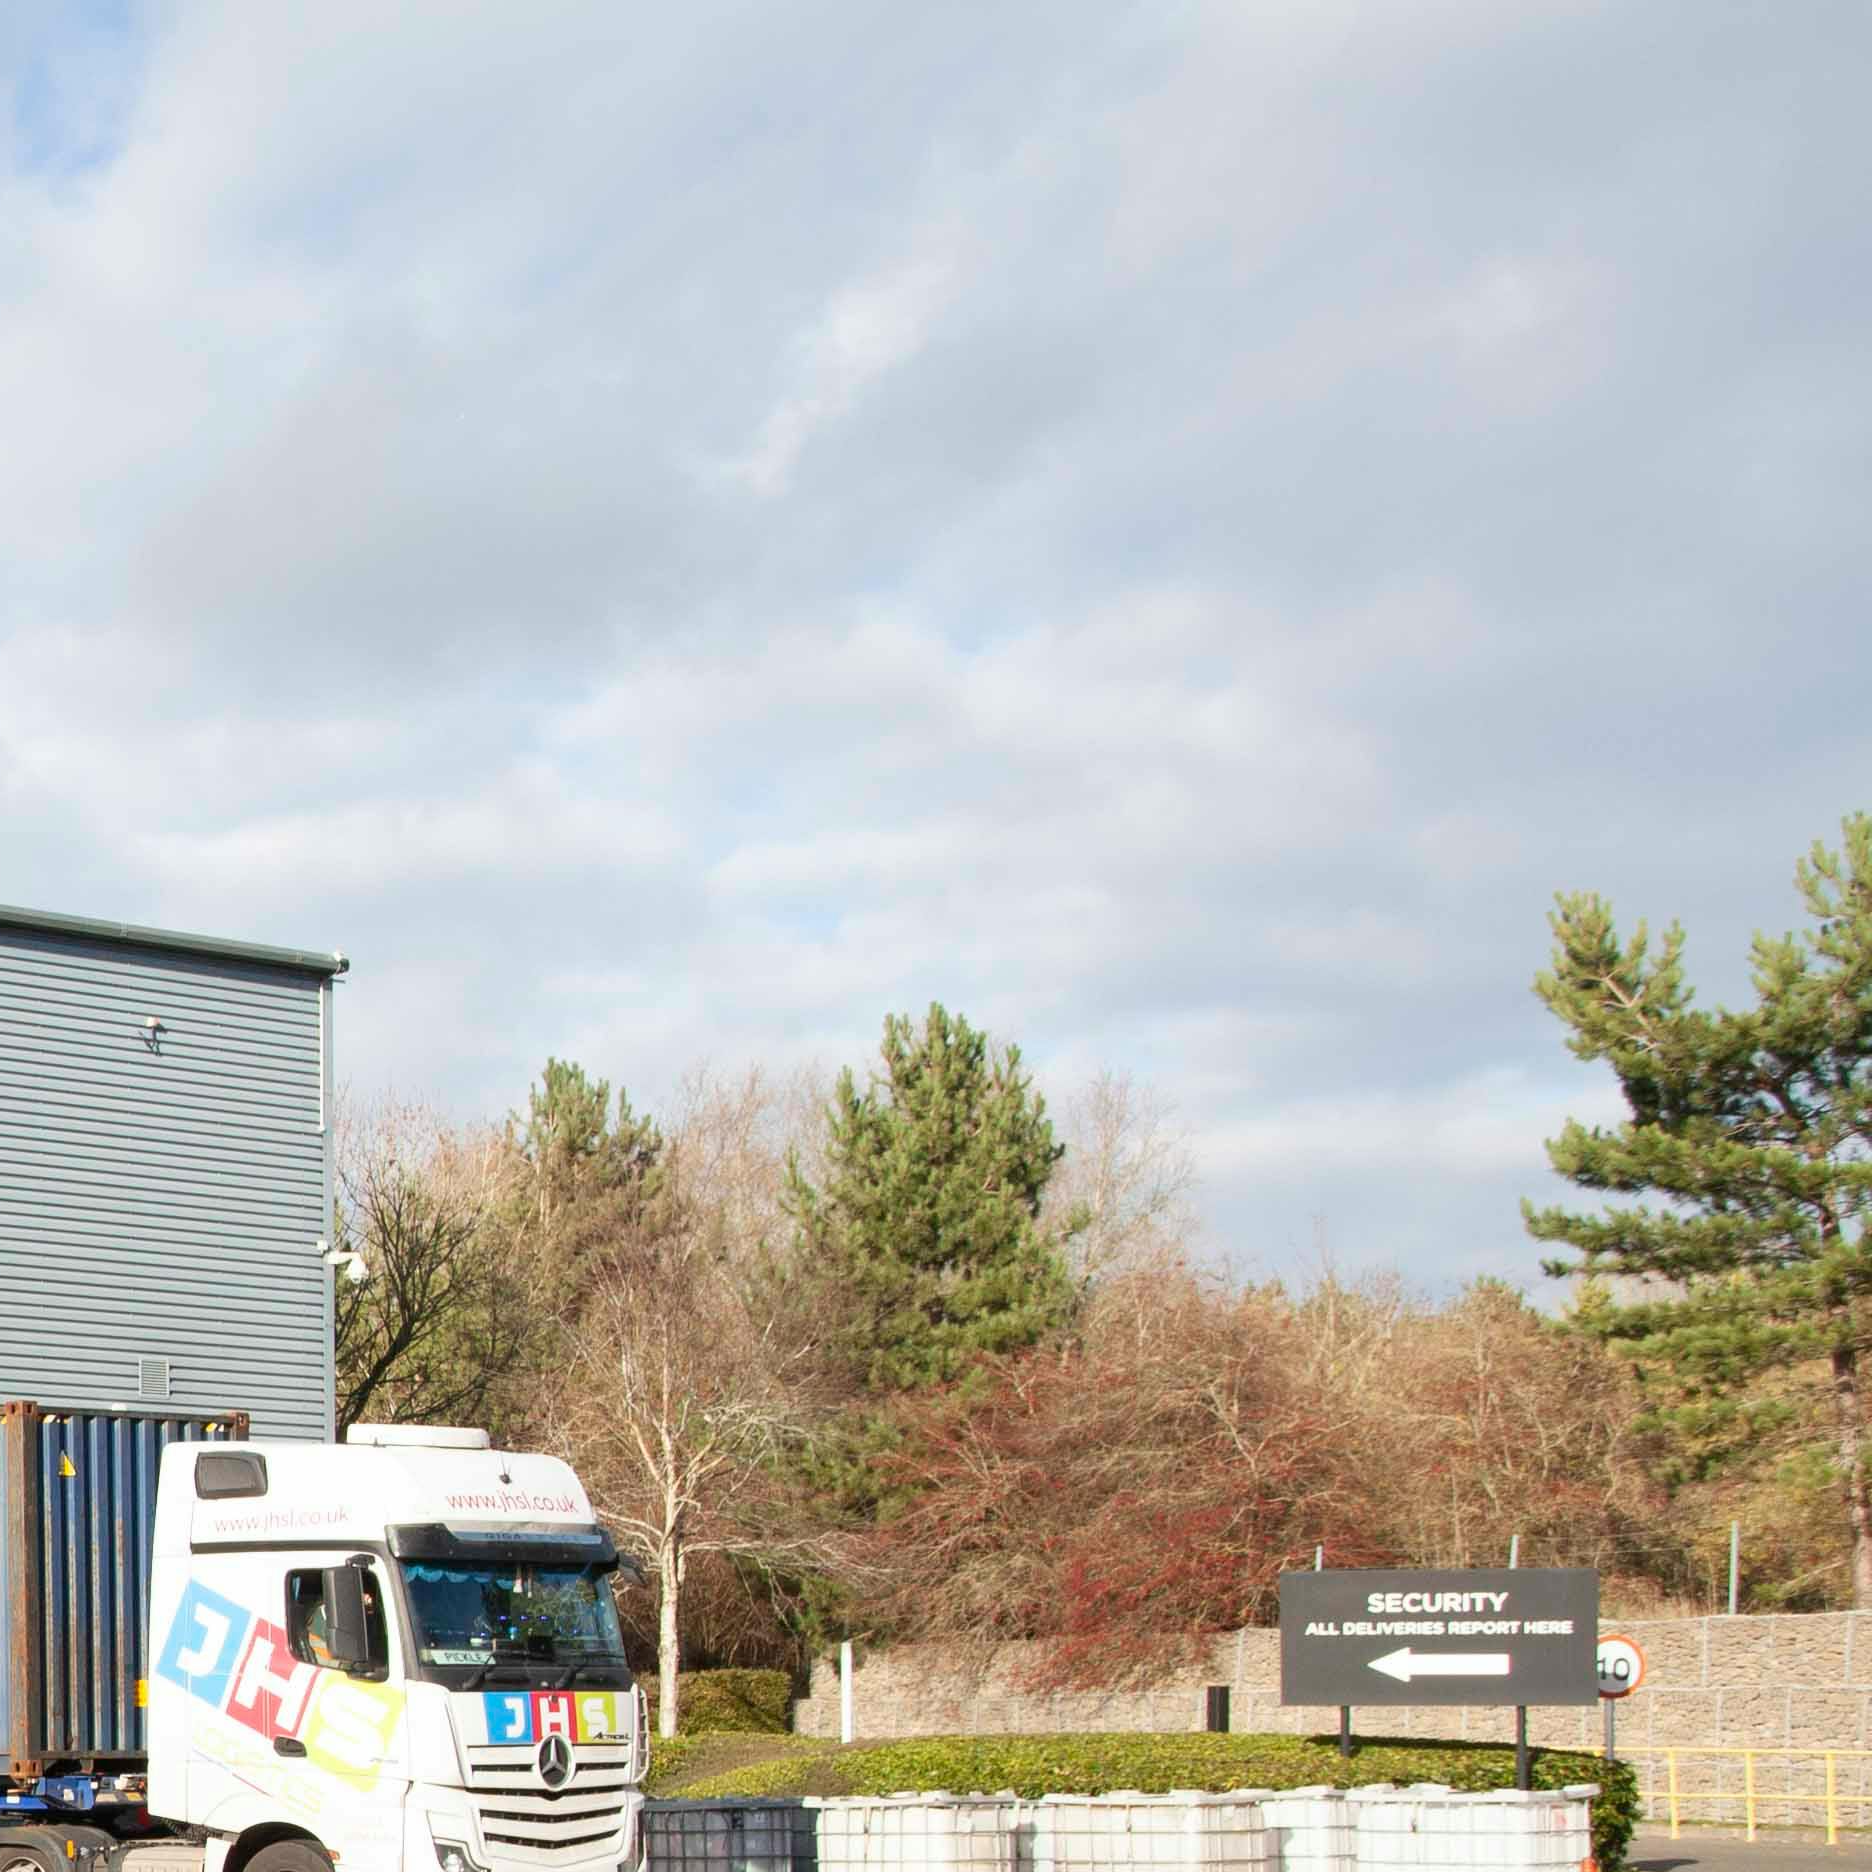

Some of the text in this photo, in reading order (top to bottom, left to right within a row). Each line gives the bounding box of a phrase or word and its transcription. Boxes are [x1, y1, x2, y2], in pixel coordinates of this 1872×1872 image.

[447, 1490, 578, 1512] www.jhsl.co.uk
[1367, 1592, 1509, 1613] SECURITY
[1304, 1620, 1574, 1636] ALL DELIVERIES REPORT HERE
[1596, 1657, 1630, 1681] 10
[175, 1601, 392, 1771] JHS
[506, 1696, 608, 1738] JHS
